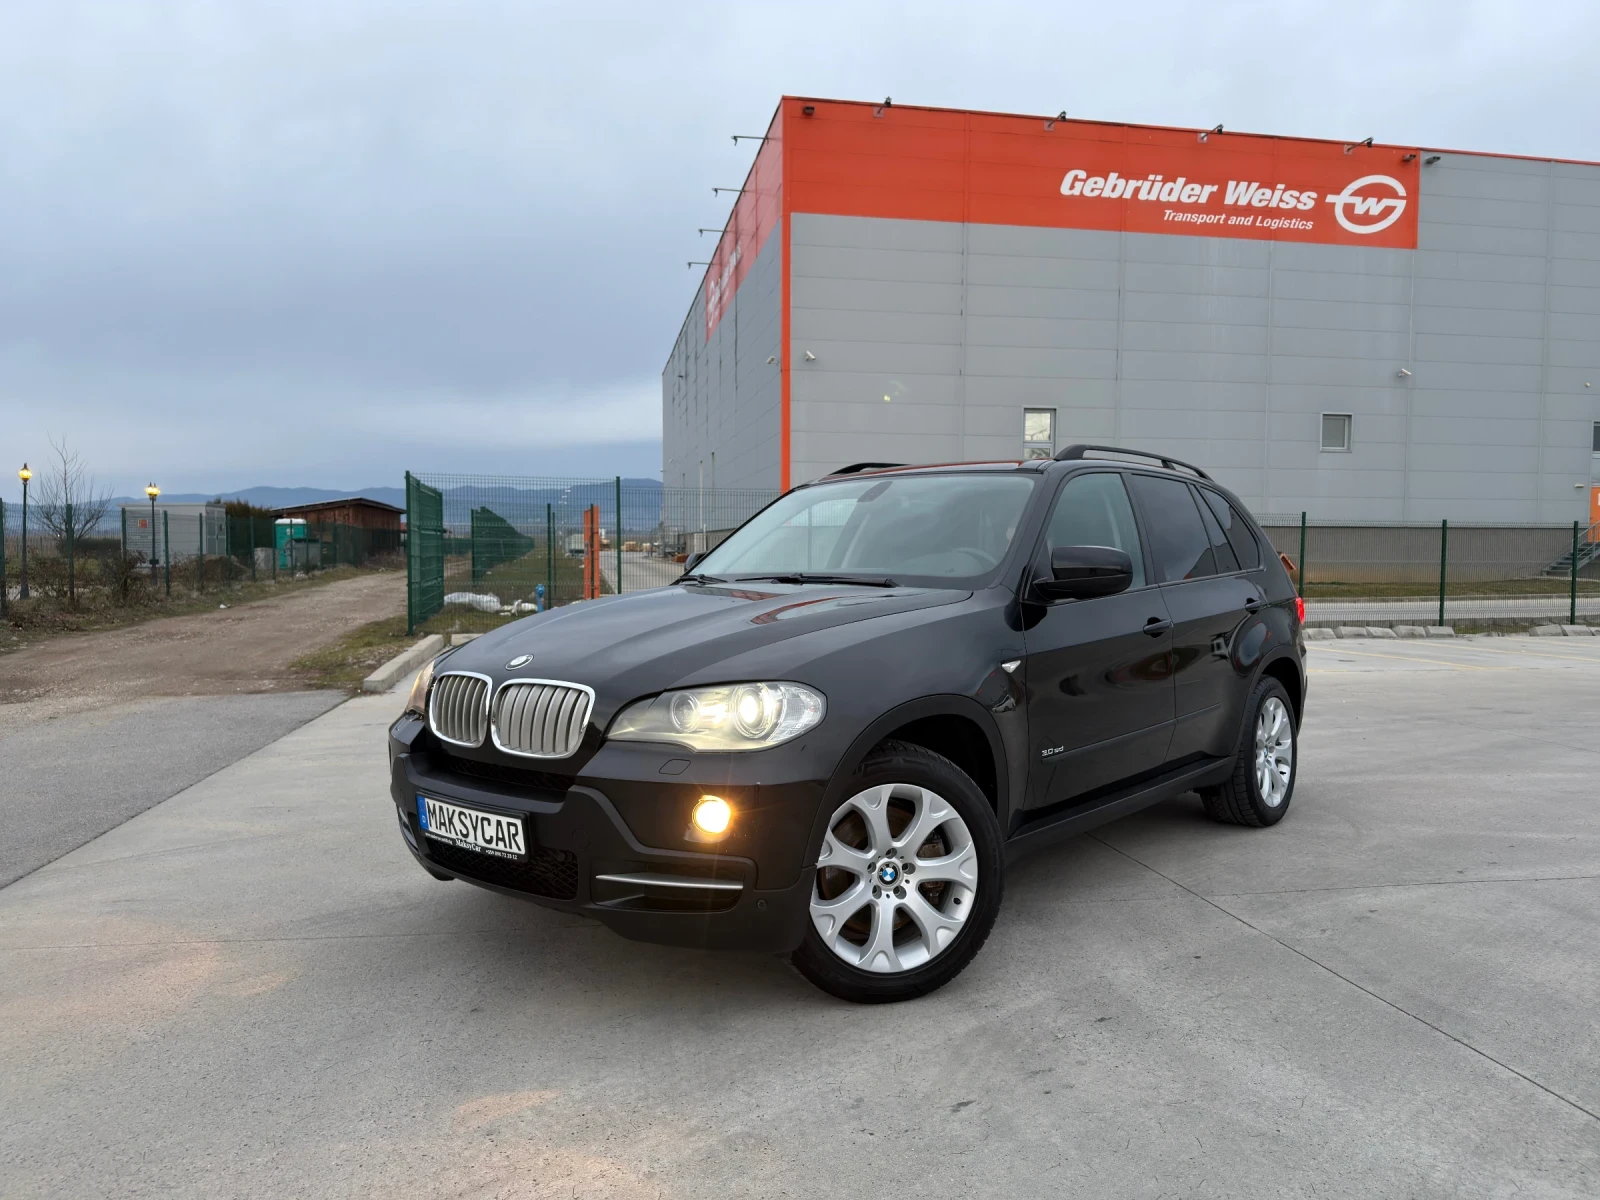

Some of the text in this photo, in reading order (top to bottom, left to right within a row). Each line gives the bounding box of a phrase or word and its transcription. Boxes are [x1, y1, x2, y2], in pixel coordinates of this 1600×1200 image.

[1060, 169, 1318, 211] Gebrüder Weiss
[1163, 209, 1314, 231] Transport and Logistics
[426, 800, 522, 852] MAKSYCAR
